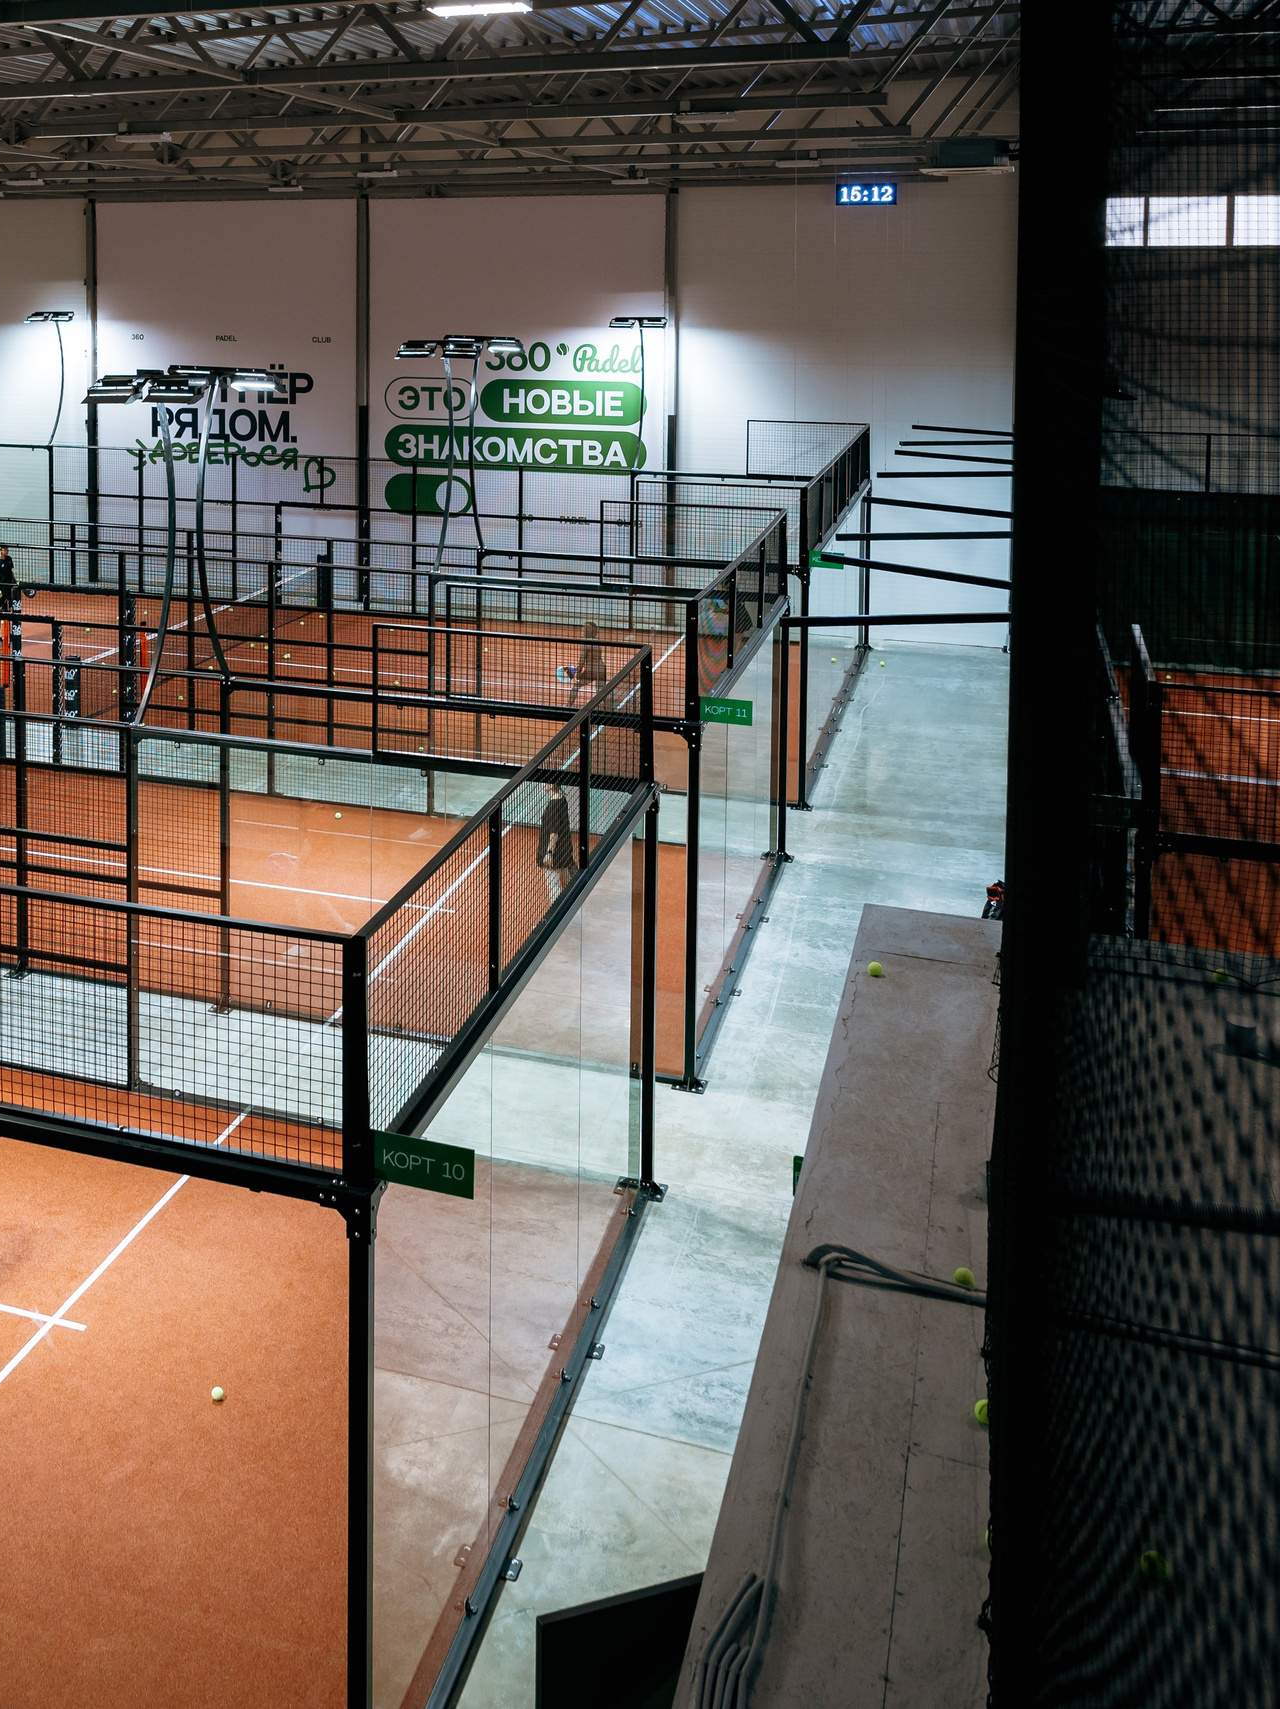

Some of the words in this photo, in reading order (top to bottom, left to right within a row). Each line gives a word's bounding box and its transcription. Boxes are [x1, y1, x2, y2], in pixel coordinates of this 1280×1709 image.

[840, 185, 893, 202] 15:12
[131, 333, 145, 341] 360
[215, 334, 237, 342] PADEL
[311, 336, 332, 344] CLUB
[572, 343, 643, 373] Padel
[397, 385, 466, 412] ЭТО
[503, 388, 624, 417] НОВЫЕ
[152, 407, 297, 443] РЯДОМ.
[397, 433, 628, 467] ЗНАКОМСТВА
[704, 705, 733, 716] КОРТ
[736, 708, 747, 718] 11
[382, 1148, 436, 1174] КОРТ
[442, 1161, 465, 1181] 10
